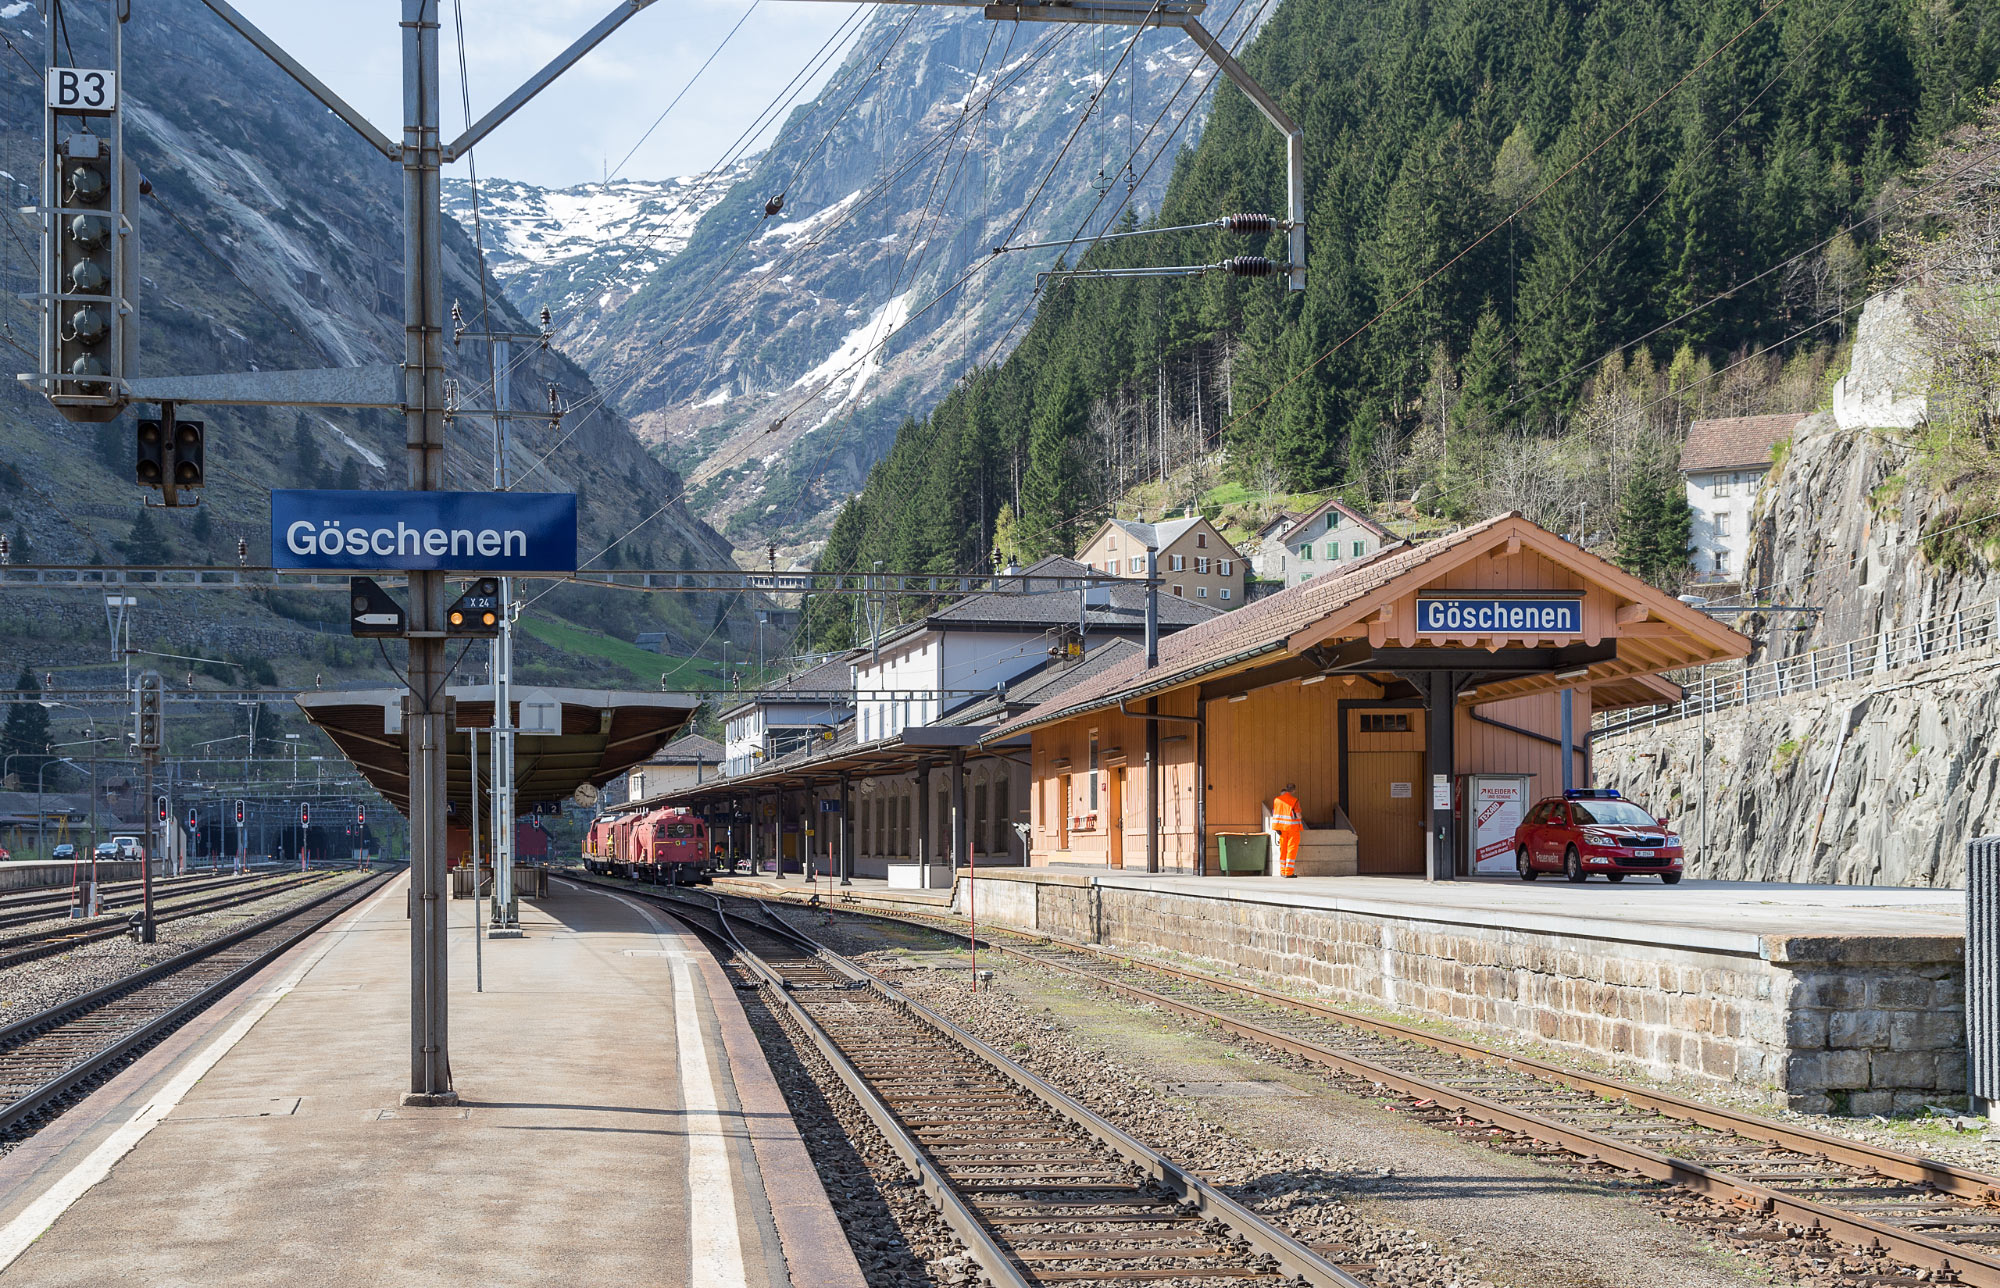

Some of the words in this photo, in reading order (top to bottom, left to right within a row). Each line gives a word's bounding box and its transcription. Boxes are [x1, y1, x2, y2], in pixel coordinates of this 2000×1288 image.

[59, 70, 105, 107] B3
[287, 520, 527, 557] Göschenen
[470, 597, 476, 608] X
[479, 598, 489, 608] 24
[1428, 602, 1571, 629] Göschenen
[1480, 801, 1500, 822] TEXAID
[1535, 851, 1559, 864] Feuerwehr
